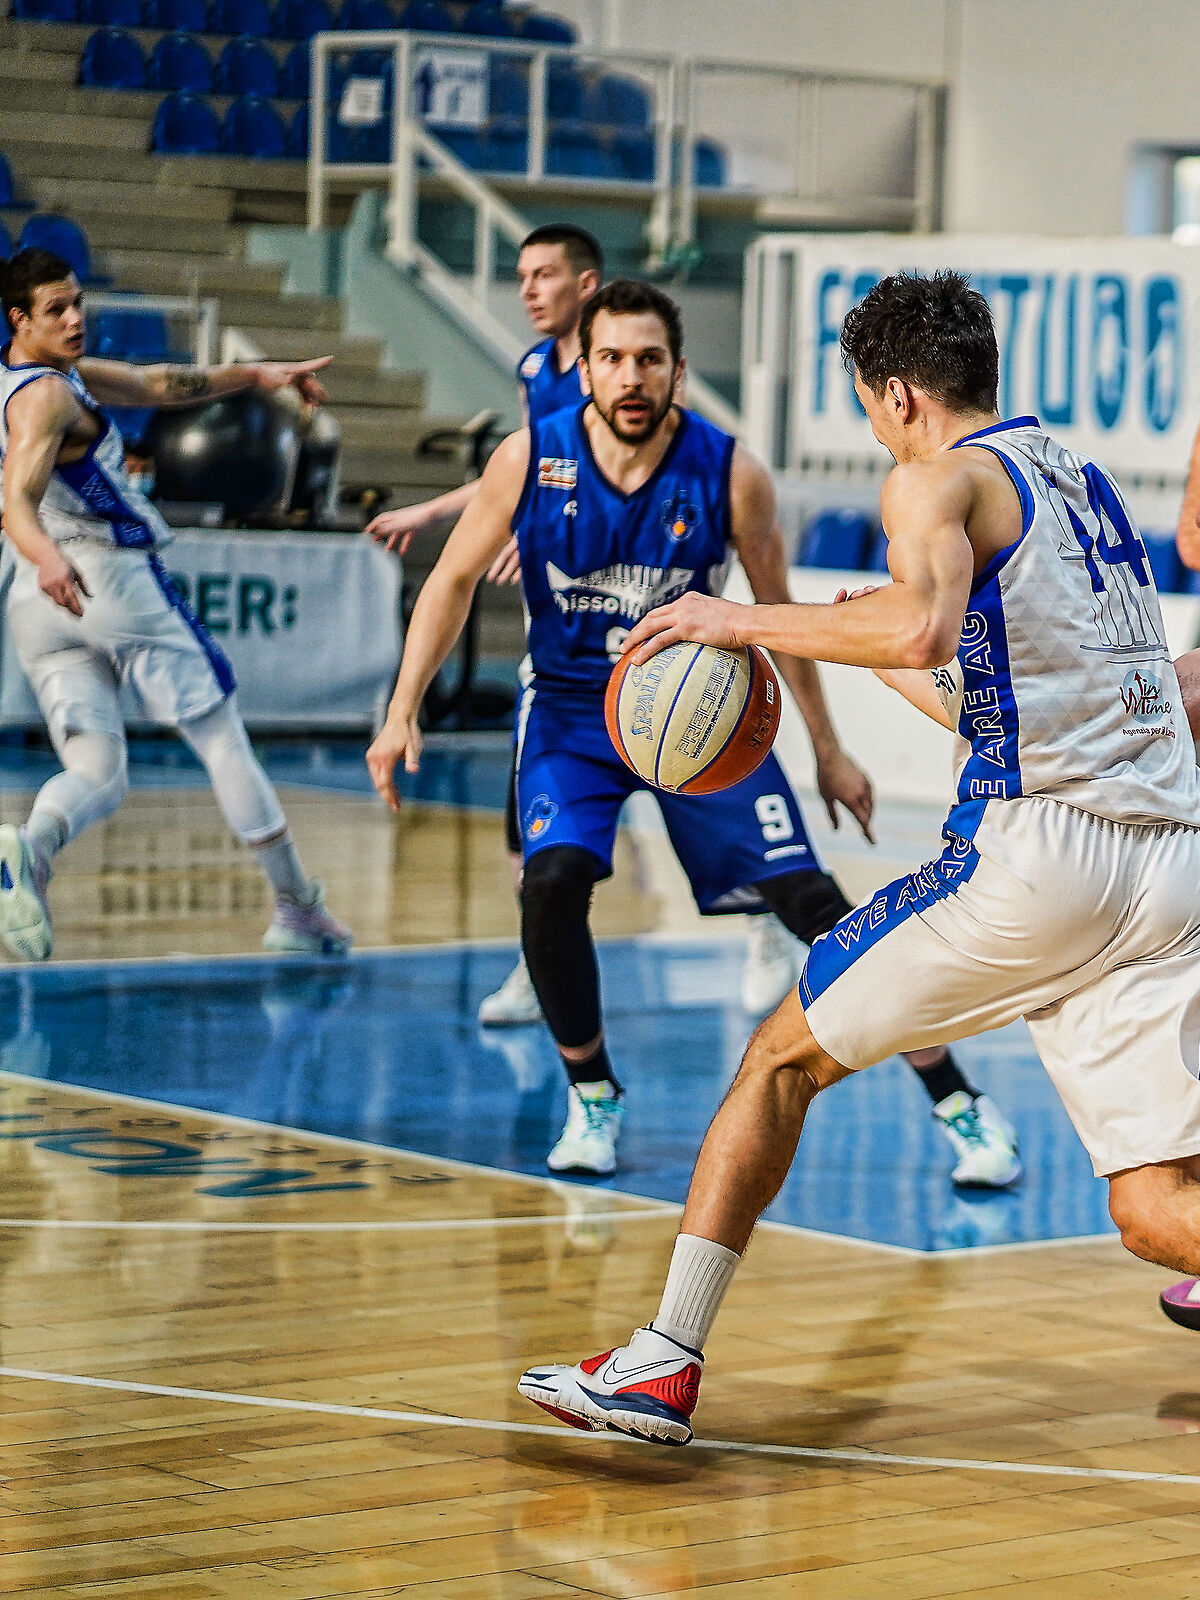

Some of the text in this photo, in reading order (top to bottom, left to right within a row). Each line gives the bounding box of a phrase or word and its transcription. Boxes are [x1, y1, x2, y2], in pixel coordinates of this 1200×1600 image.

[1042, 460, 1151, 593] 14
[631, 642, 691, 741] SPALDIN
[675, 650, 732, 756] PRECISION
[958, 610, 1008, 800] E ARE AG
[754, 793, 795, 843] 9
[834, 896, 888, 951] WE
